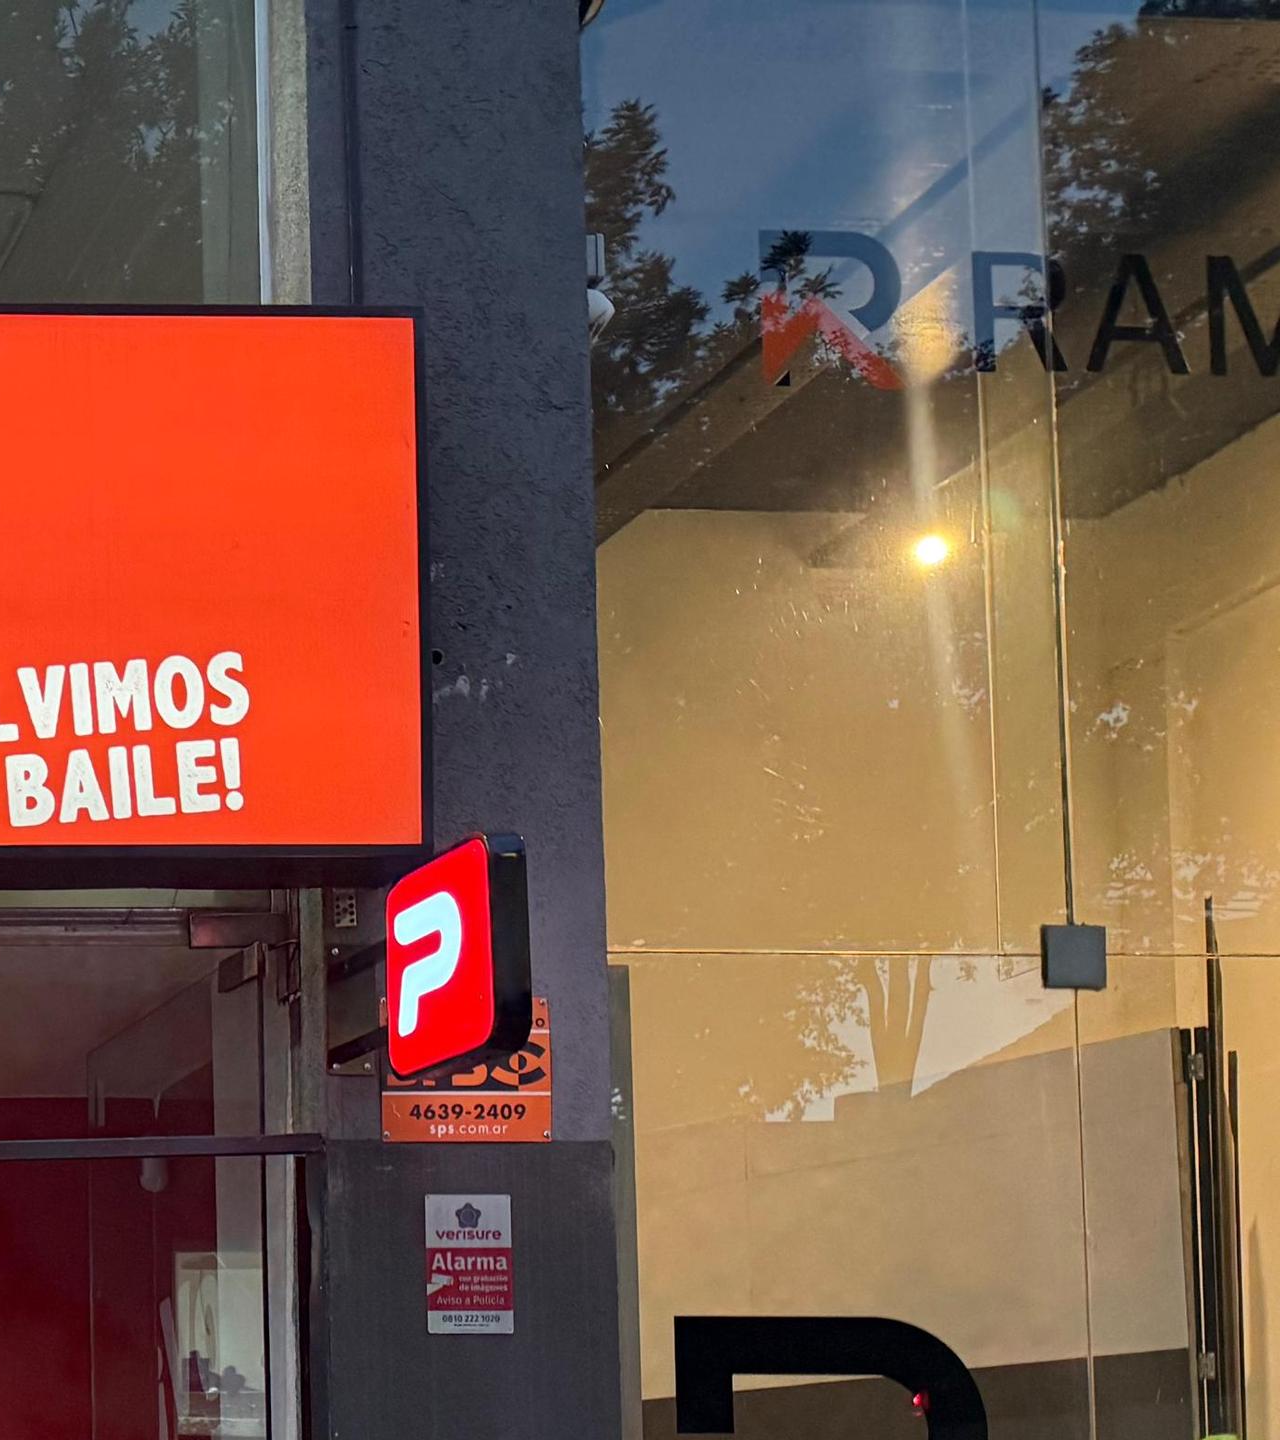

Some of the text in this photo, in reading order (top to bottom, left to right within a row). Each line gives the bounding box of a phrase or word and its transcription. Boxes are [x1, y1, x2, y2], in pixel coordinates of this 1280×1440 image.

[4, 737, 244, 828] BAILE!
[409, 1103, 527, 1121] 4639-2409
[429, 1122, 509, 1138] sps.com.ar
[435, 1229, 502, 1241] verisure
[431, 1251, 508, 1271] Alarma
[437, 1294, 505, 1305] Aviso a Policía
[465, 1315, 479, 1323] 222
